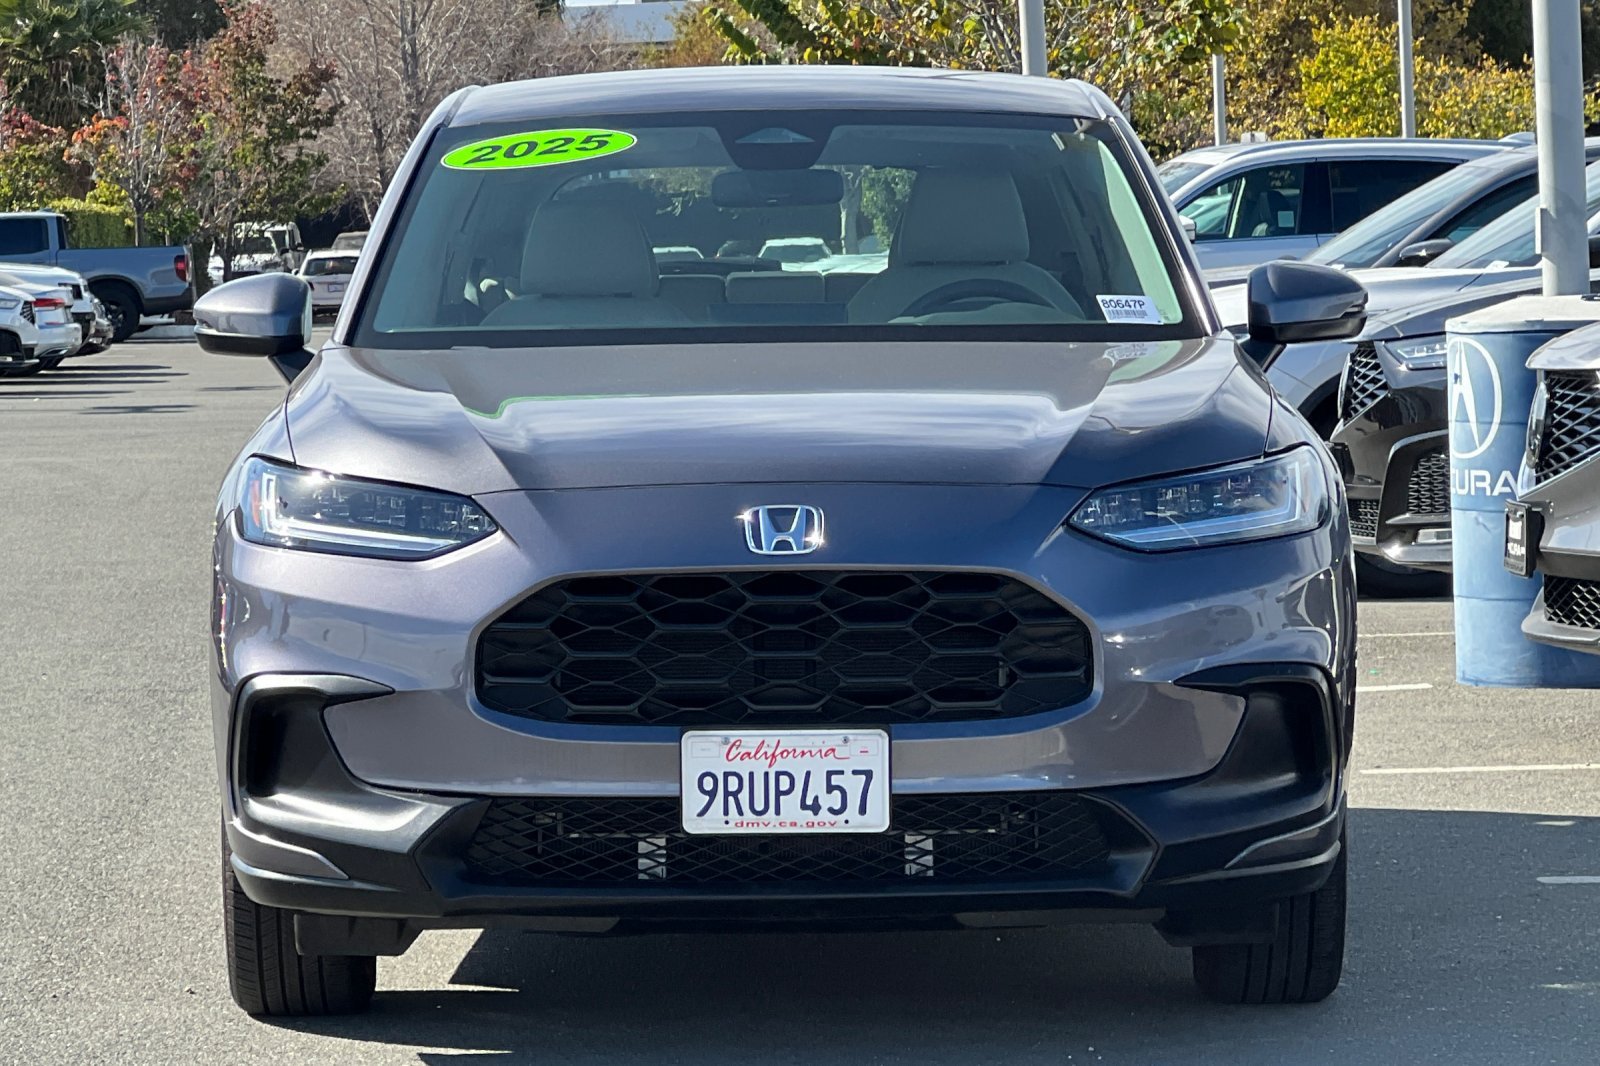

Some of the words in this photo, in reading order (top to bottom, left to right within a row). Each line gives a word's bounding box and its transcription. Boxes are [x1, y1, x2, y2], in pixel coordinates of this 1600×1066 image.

[463, 133, 613, 165] 2025
[1101, 299, 1145, 309] 80647P
[725, 738, 850, 768] California
[696, 769, 874, 817] 9RUP457
[734, 819, 838, 828] dmv.ca.gov
